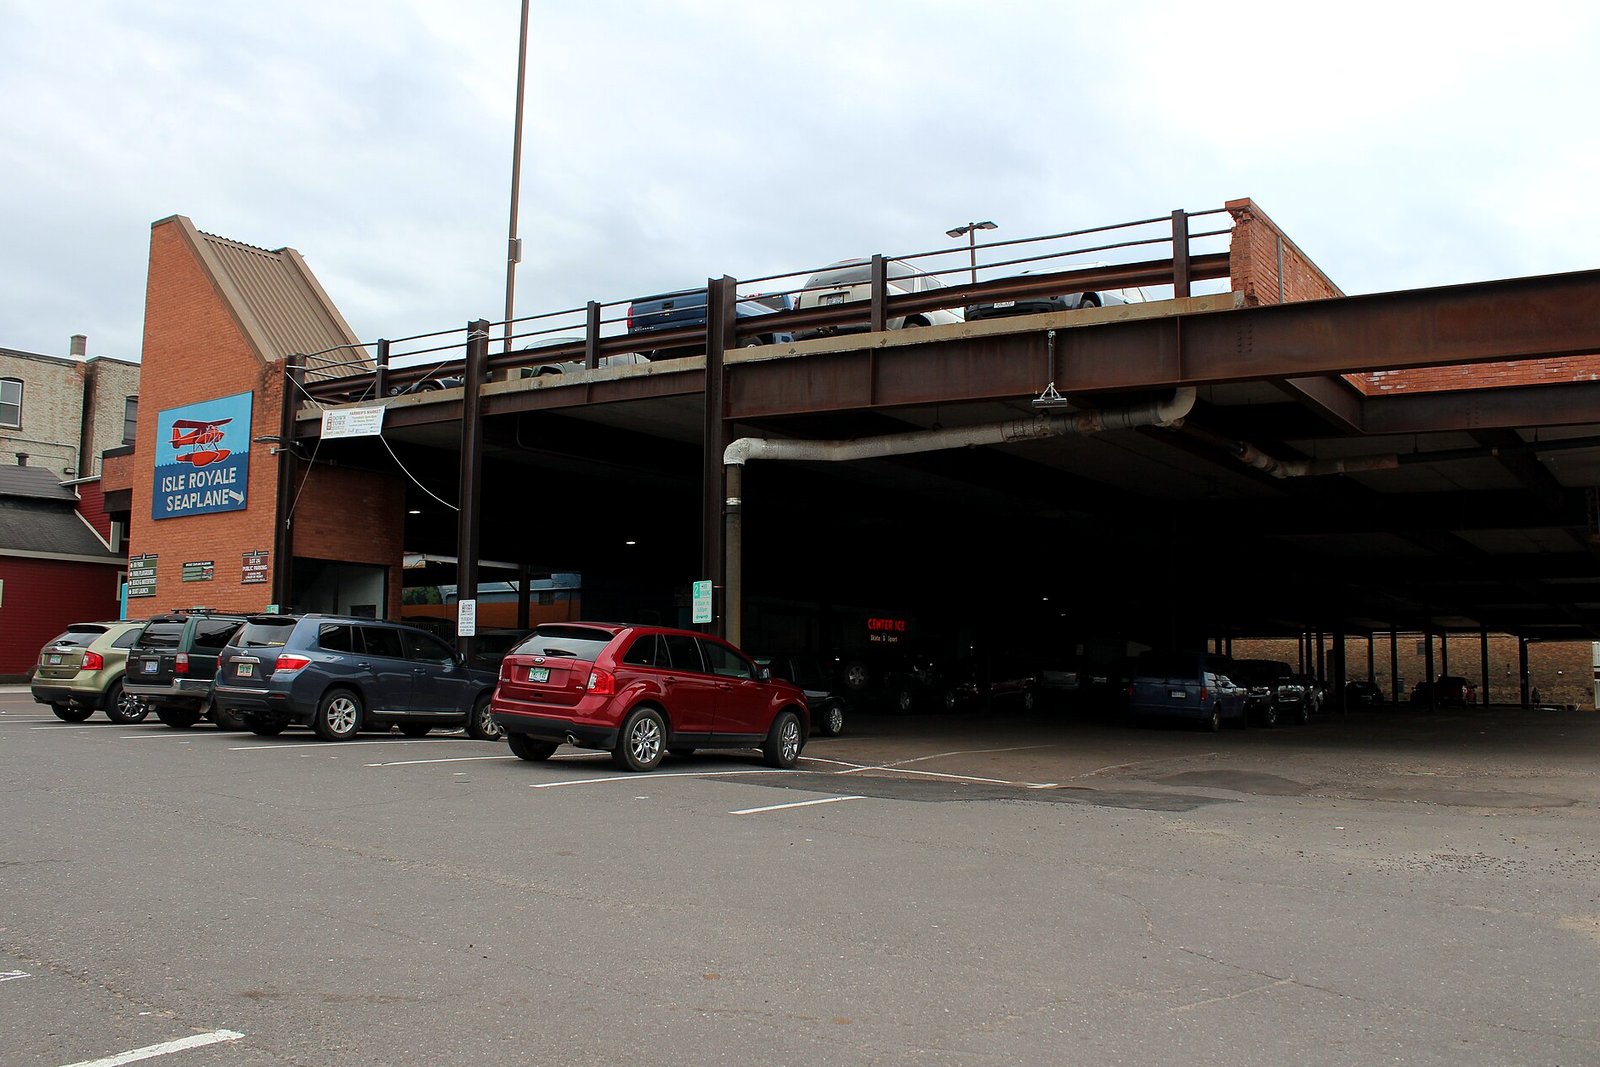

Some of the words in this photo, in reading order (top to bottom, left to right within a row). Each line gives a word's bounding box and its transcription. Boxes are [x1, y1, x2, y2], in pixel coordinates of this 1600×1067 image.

[162, 474, 186, 493] ISLE
[189, 467, 237, 489] ROYALE
[166, 488, 230, 512] SEAPLANE
[868, 618, 893, 630] CENTER
[894, 620, 905, 631] ICE
